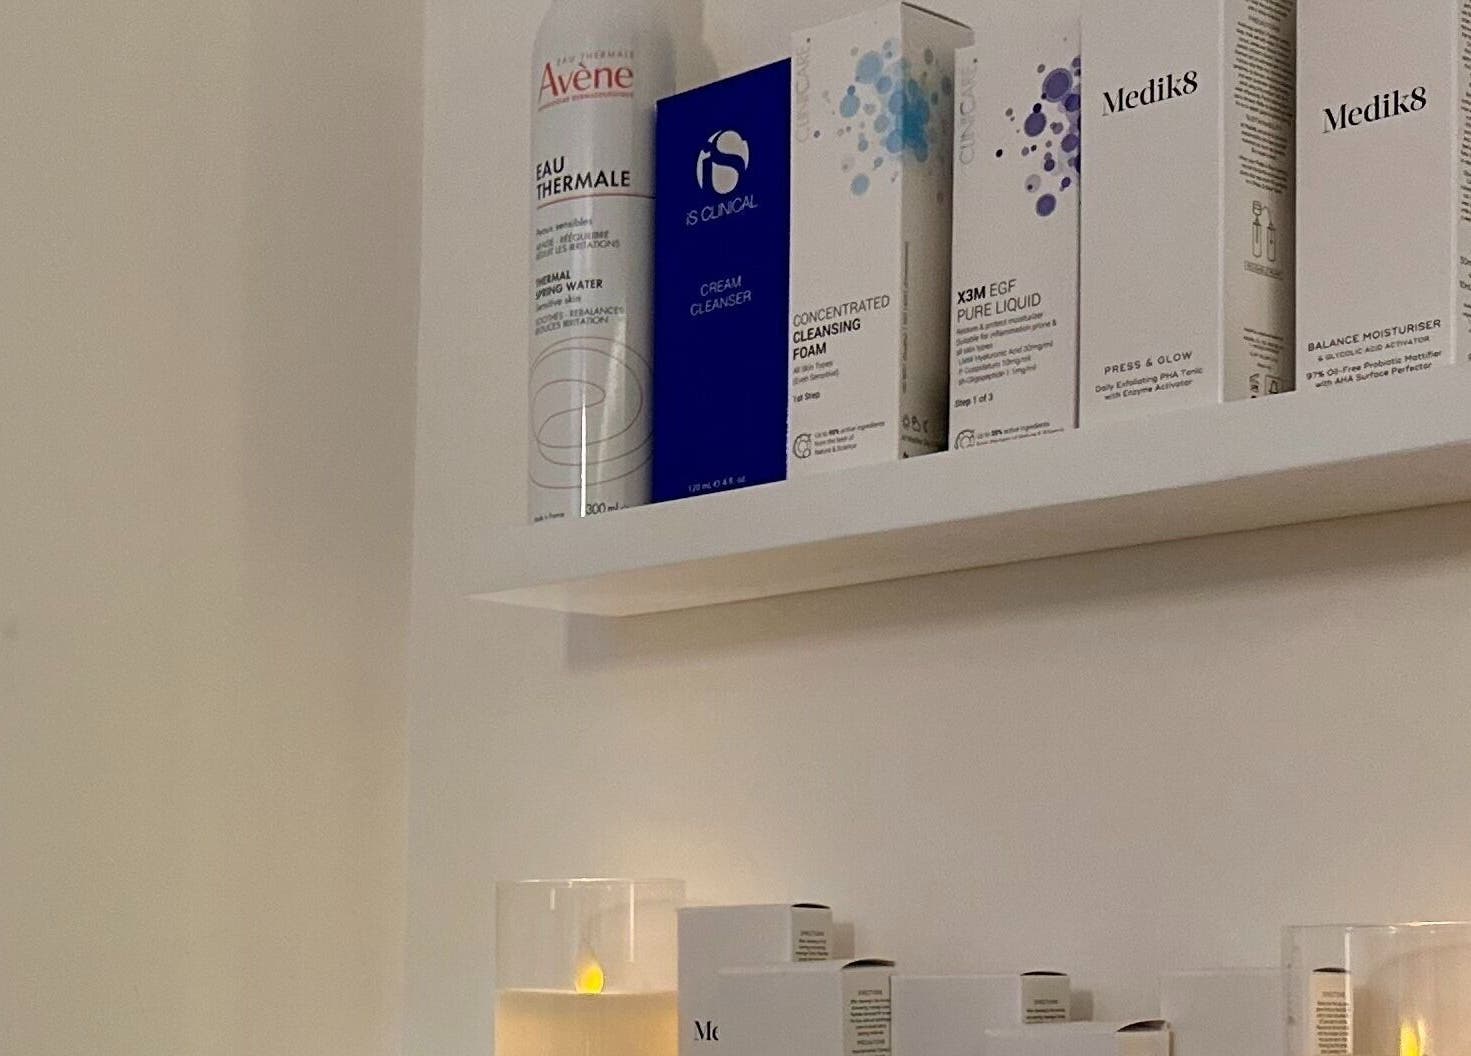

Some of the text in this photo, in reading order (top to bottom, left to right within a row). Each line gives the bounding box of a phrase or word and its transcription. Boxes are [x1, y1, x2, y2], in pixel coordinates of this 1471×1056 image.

[538, 62, 634, 102] Avène
[1102, 70, 1198, 117] Medik8
[1323, 86, 1427, 133] Medik8
[536, 156, 565, 182] EAU
[536, 170, 631, 200] THERMALE
[701, 194, 758, 222] CLINICAL
[566, 279, 603, 292] WATER
[700, 275, 742, 297] CREAM
[957, 279, 1017, 305] X3M EGF
[690, 289, 752, 317] CLEANSER
[793, 294, 890, 328] CONCENTRATED
[957, 292, 1042, 323] PURE LIQUID
[793, 318, 861, 344] CLEANSING
[1308, 334, 1359, 352] BALANCE
[1363, 319, 1441, 341] MOISTURISER
[1365, 343, 1383, 352] ACID
[1385, 335, 1430, 349] ACTIVATOR
[793, 342, 827, 360] FOAM
[1095, 367, 1203, 393] Daily Exfoliating PHA Tonic
[1104, 360, 1141, 376] PRESS
[1146, 358, 1153, 367] &
[1334, 376, 1353, 385] AHA
[1356, 369, 1389, 382] Surface
[1391, 362, 1432, 375] Perfector
[804, 391, 821, 401] Step
[1155, 379, 1193, 391] Activator
[954, 393, 987, 408] Step of
[586, 502, 606, 515] 300
